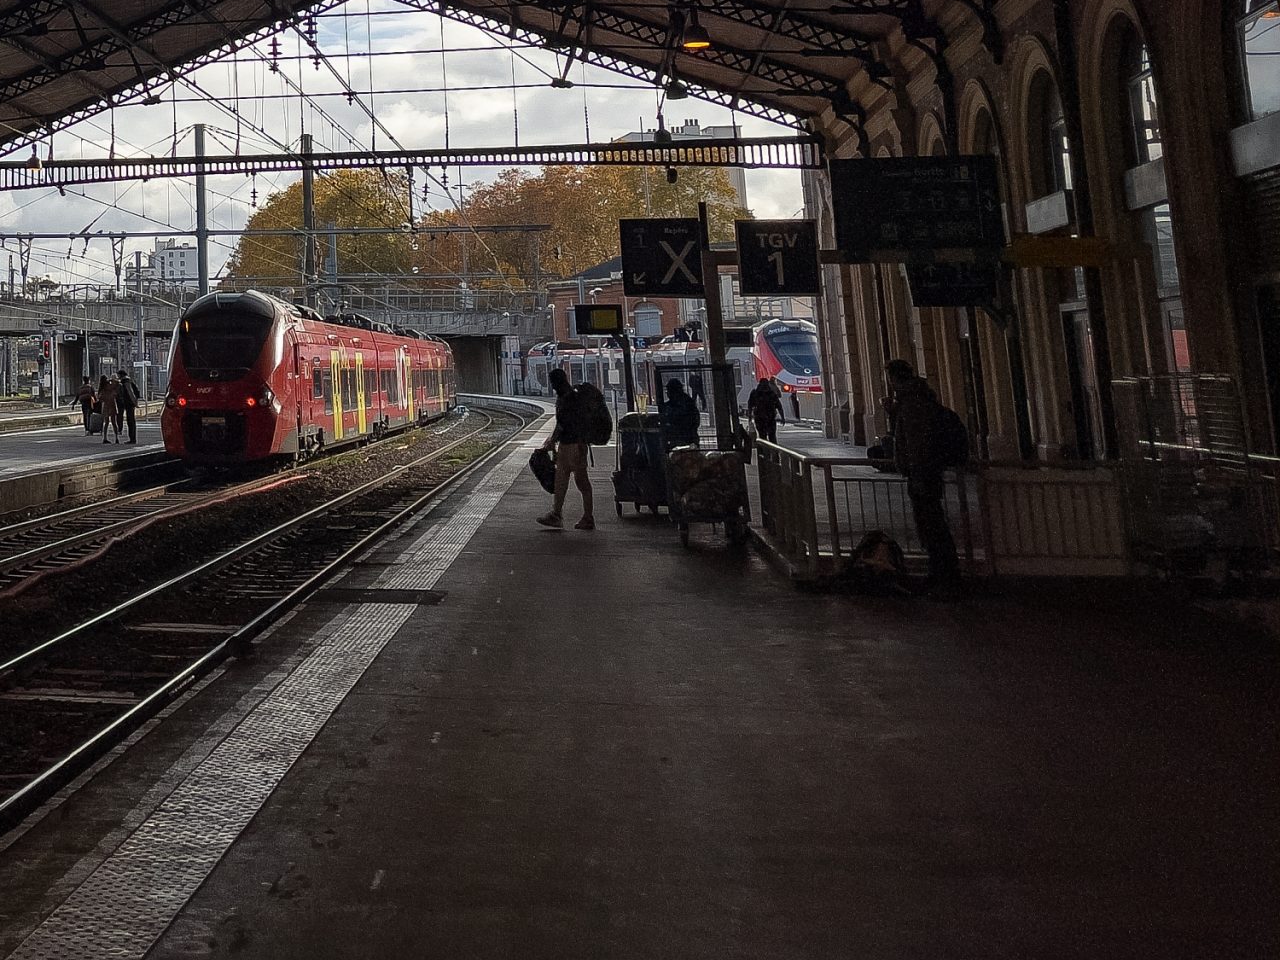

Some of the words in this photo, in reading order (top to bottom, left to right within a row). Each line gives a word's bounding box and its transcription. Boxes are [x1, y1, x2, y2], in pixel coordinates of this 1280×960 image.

[755, 232, 799, 249] TGV
[658, 240, 699, 285] X
[767, 250, 785, 286] 1
[685, 330, 695, 342] Y
